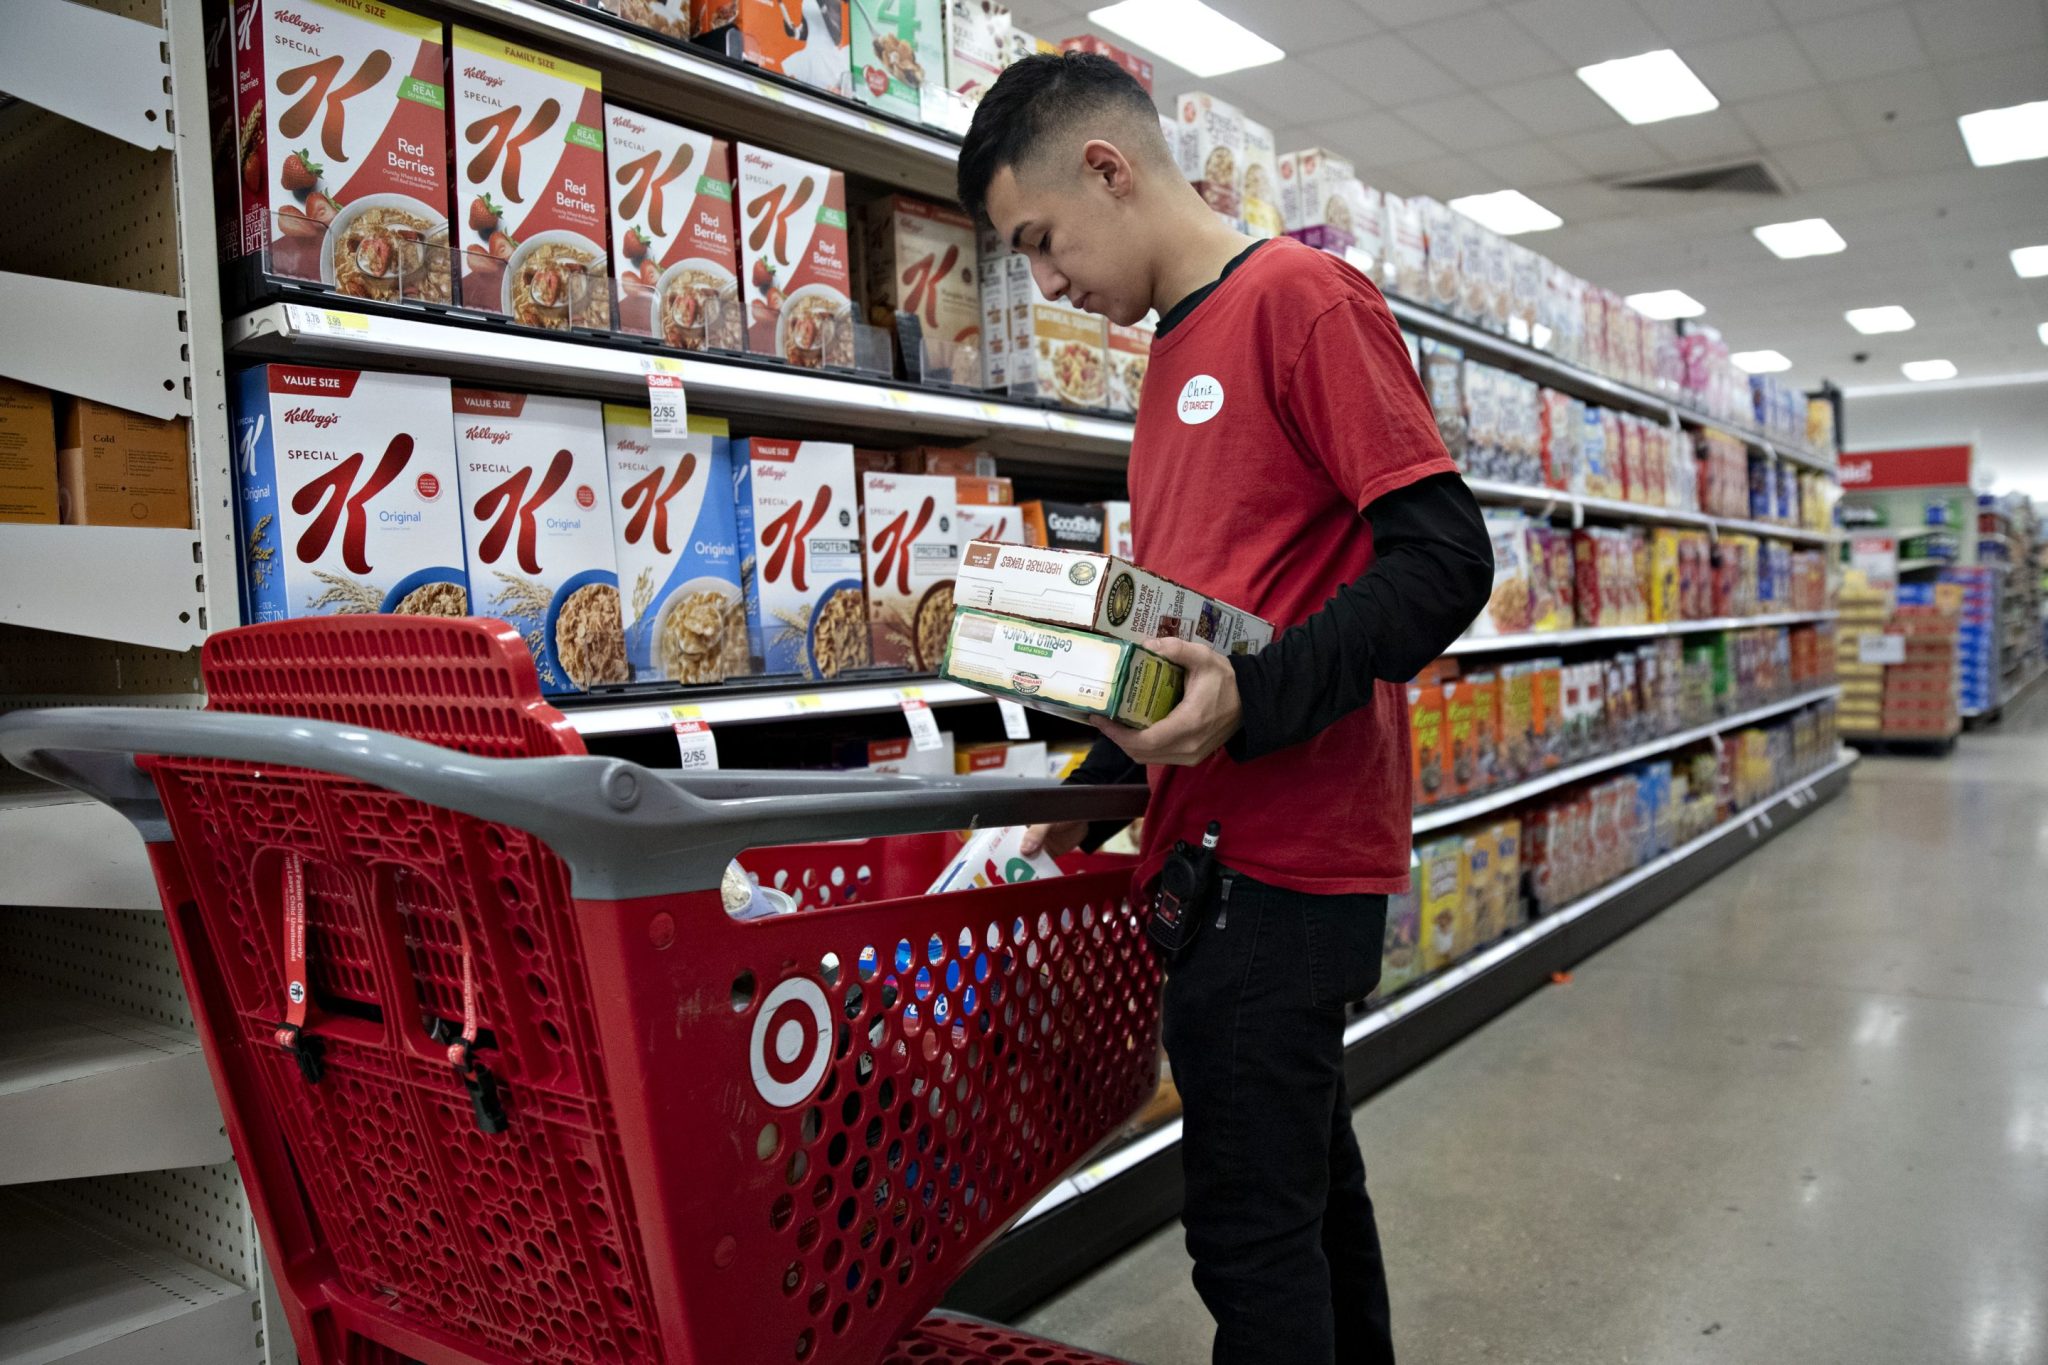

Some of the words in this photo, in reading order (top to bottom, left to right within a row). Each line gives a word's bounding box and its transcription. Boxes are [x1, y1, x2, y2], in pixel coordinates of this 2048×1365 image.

[365, 4, 386, 19] SIZE
[274, 10, 324, 34] Kellogg's
[275, 35, 321, 57] SPECIAL
[505, 46, 536, 63] FAMILY
[537, 57, 555, 70] SIZE
[240, 68, 251, 80] Red
[464, 67, 505, 88] Kellogg's
[240, 77, 259, 94] Berries
[412, 84, 436, 99] REAL
[276, 49, 392, 163] K
[464, 90, 503, 108] SPECIAL
[576, 128, 597, 141] REAL
[612, 116, 647, 135] Kellogg's
[398, 137, 424, 157] Red
[465, 97, 561, 203] K
[613, 137, 646, 153] SPECIAL
[388, 151, 435, 177] Berries
[744, 153, 774, 169] Kellogg's
[565, 178, 586, 196] Red
[744, 173, 773, 187] SPECIAL
[615, 143, 694, 238] K
[556, 191, 596, 214] Berries
[701, 212, 719, 227] Red
[747, 175, 814, 266] K
[694, 224, 728, 244] Berries
[818, 240, 835, 255] Red
[813, 254, 842, 269] Berries
[902, 245, 959, 328] K
[283, 375, 317, 387] VALUE
[319, 377, 340, 389] SIZE
[1187, 380, 1212, 398] Chris
[464, 398, 490, 409] VALUE
[491, 400, 511, 410] SIZE
[653, 406, 675, 418] 2/$5
[1188, 400, 1214, 411] TARGET
[284, 407, 341, 428] Kellogg's
[93, 434, 115, 443] Cold
[465, 426, 512, 444] Kellogg's
[240, 414, 265, 476] K
[616, 440, 649, 454] Kellogg's
[288, 450, 339, 461] SPECIAL
[469, 463, 512, 474] SPECIAL
[618, 462, 650, 472] SPECIAL
[756, 467, 787, 480] Kellogg's
[243, 484, 270, 504] Original
[758, 498, 788, 507] SPECIAL
[291, 432, 415, 575] K
[473, 449, 574, 575] K
[621, 452, 697, 555] K
[379, 510, 421, 525] Original
[546, 518, 581, 531] Original
[761, 484, 832, 592] K
[812, 543, 849, 551] PROTEIN
[871, 496, 935, 596] K
[695, 541, 735, 559] Original
[915, 546, 947, 555] PROTEIN
[683, 750, 706, 763] 2/$5
[287, 870, 295, 893] Leave
